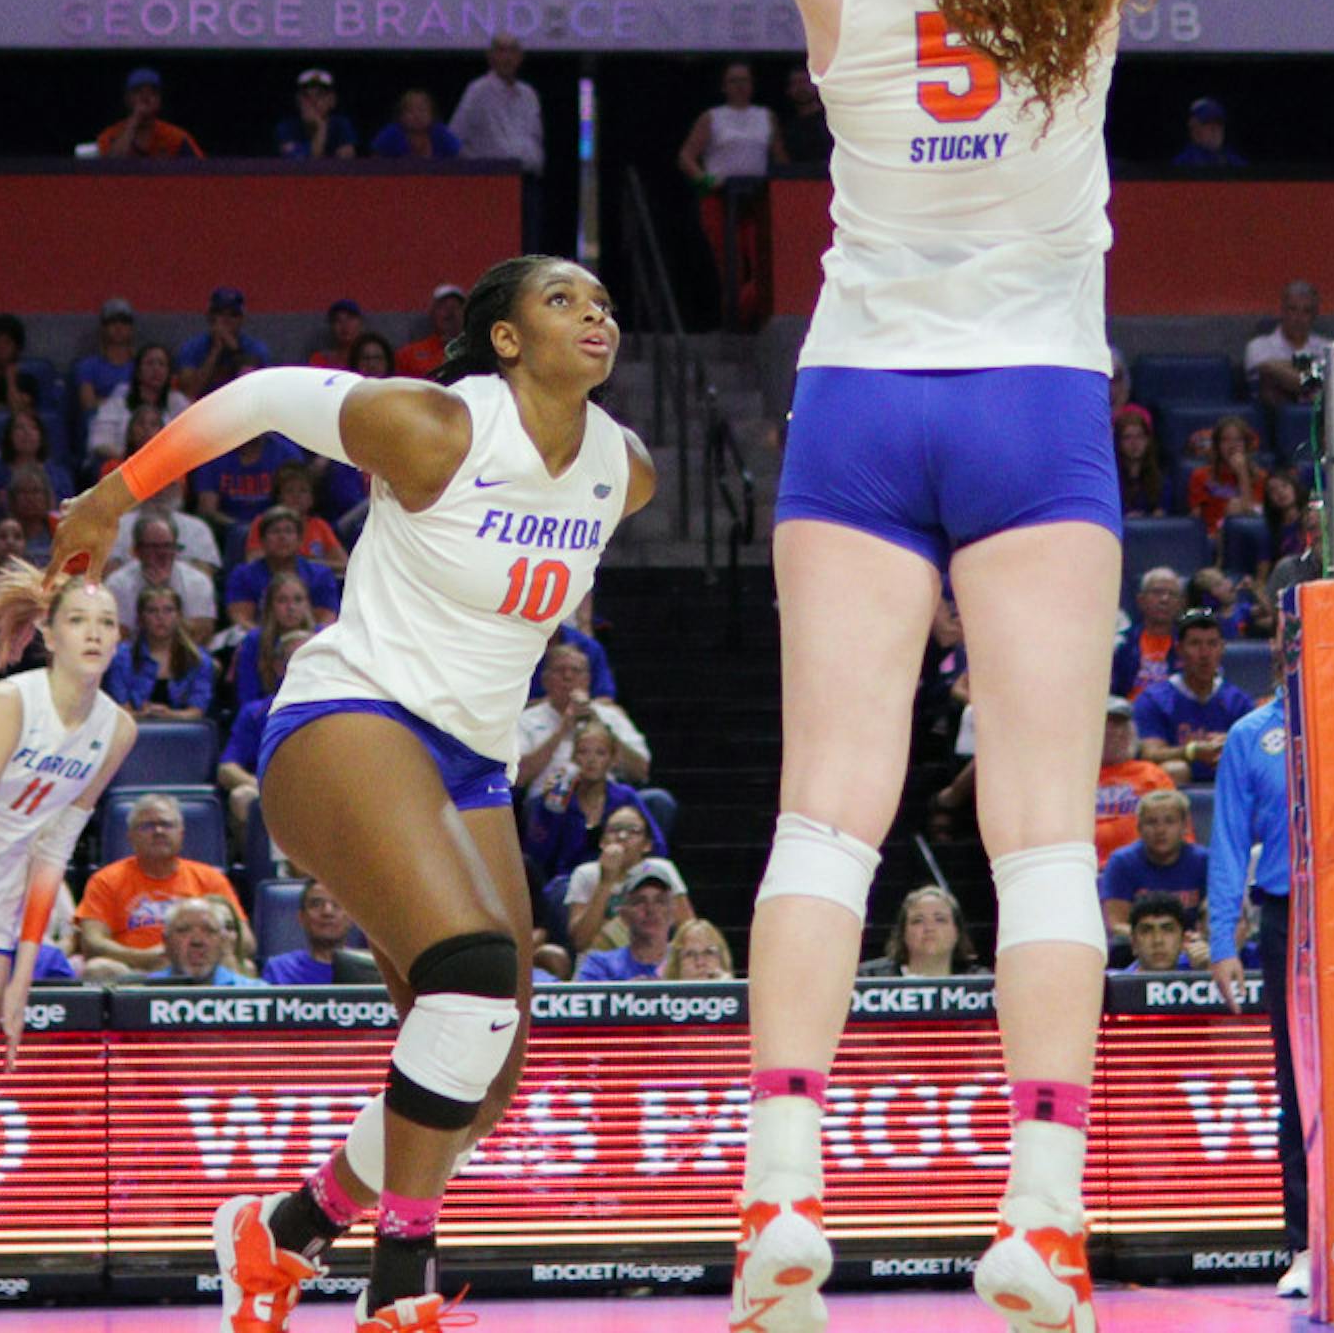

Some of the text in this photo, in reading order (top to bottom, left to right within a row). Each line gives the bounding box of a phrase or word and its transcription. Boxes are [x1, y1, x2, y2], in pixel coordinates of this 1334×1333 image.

[61, 0, 303, 37] GEORGE
[334, 0, 541, 37] BRAND
[915, 11, 1002, 124] 5
[910, 132, 1010, 163] STUCKY
[475, 509, 602, 550] FLORIDA
[496, 556, 571, 623] 10
[10, 778, 56, 816] 11
[150, 998, 273, 1023] ROCKET
[531, 991, 740, 1022] CKET Mortgage
[850, 986, 938, 1014] OCKET
[533, 1262, 705, 1283] ROCKET Mortgage
[871, 1258, 951, 1277] ROCKET
[1193, 1252, 1259, 1270] ROCKET
[298, 1275, 370, 1295] ortgage
